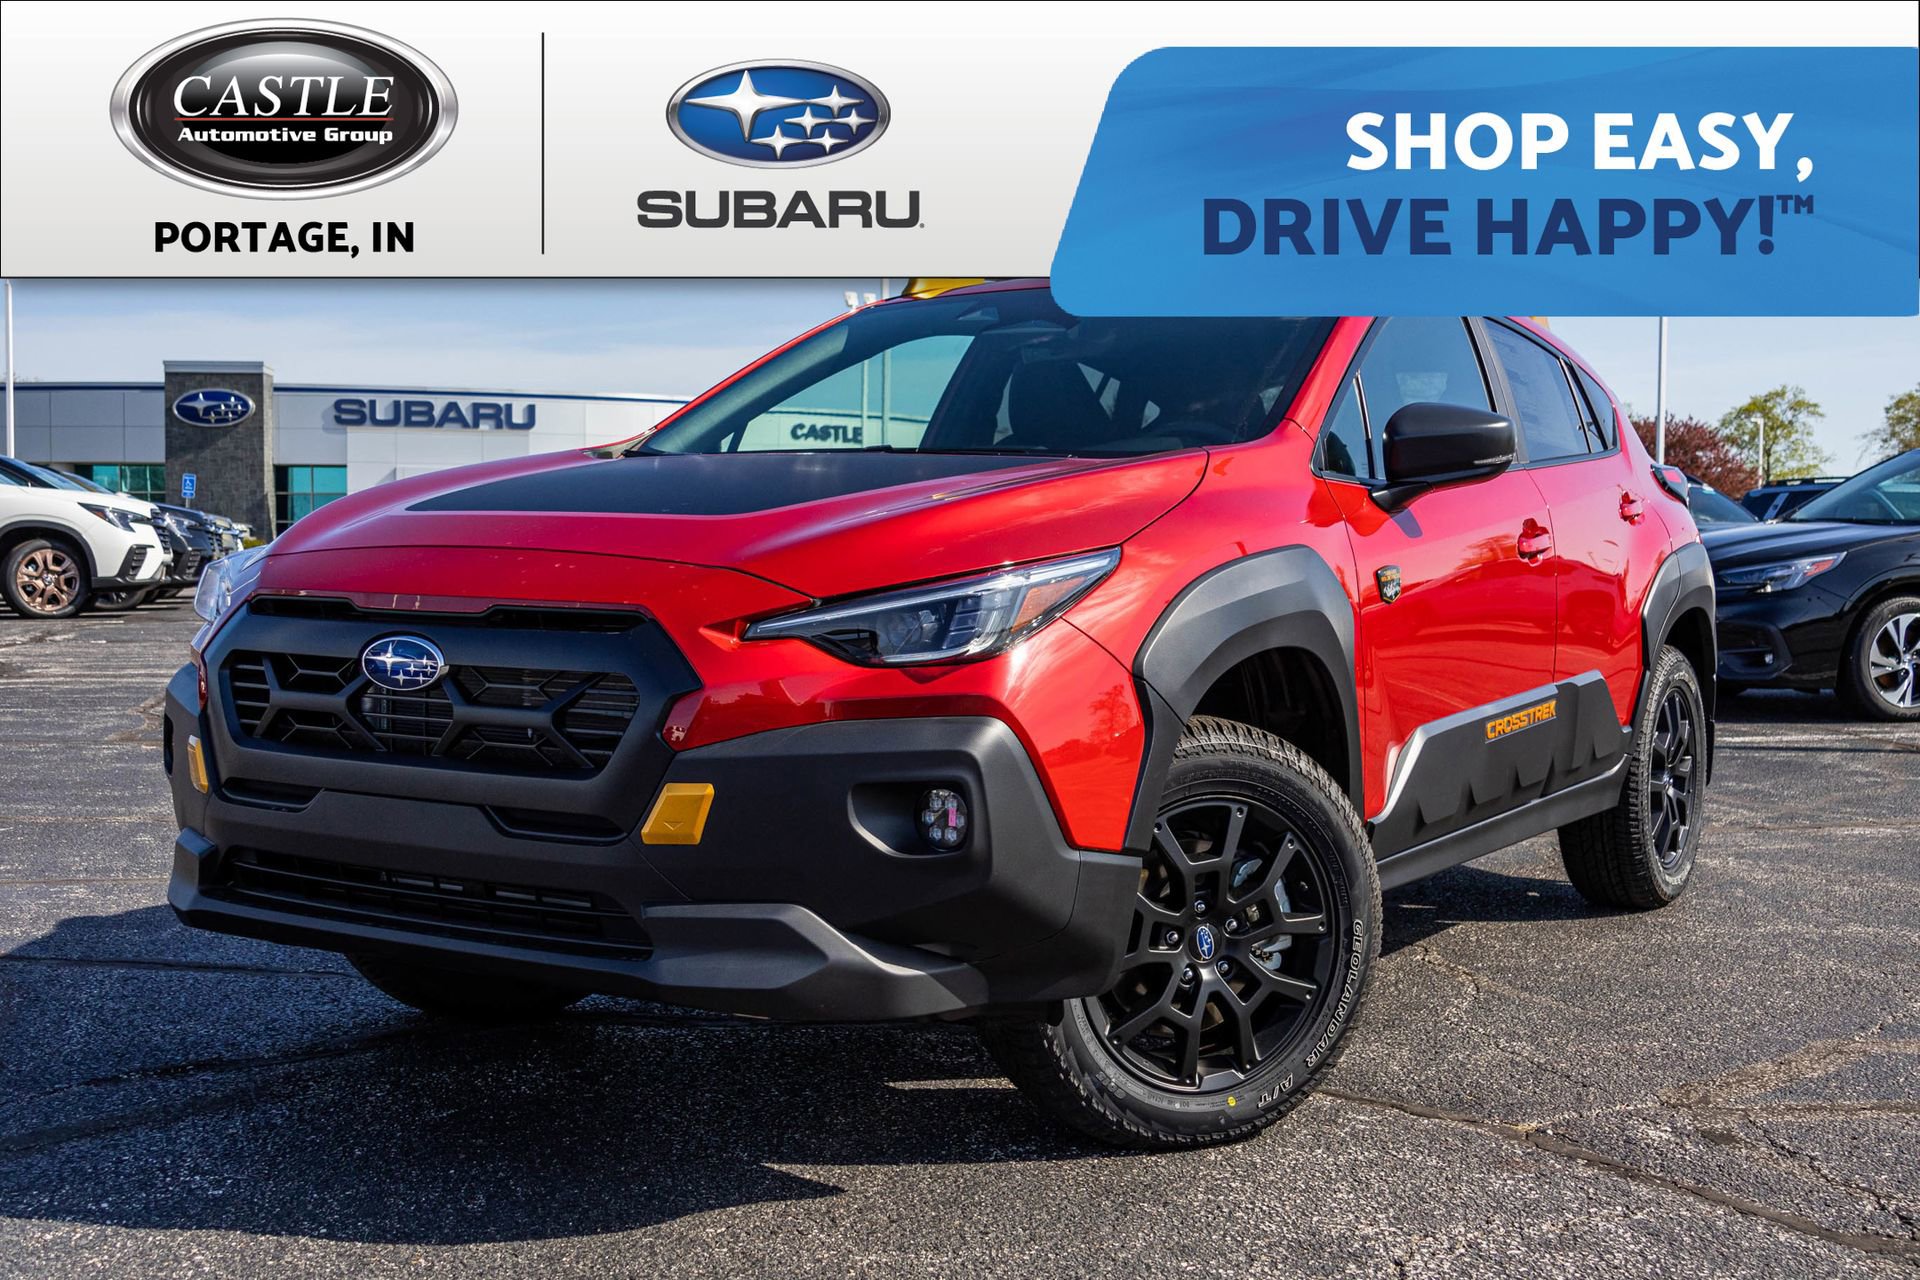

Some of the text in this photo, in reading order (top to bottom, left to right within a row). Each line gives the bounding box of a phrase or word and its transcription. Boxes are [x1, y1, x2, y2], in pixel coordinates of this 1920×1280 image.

[334, 398, 536, 430] SUBARU
[790, 422, 863, 444] CASTLE
[1486, 699, 1557, 740] CROSSTREK
[1306, 919, 1363, 1068] GEOLANDAR
[1258, 1072, 1294, 1108] A/T
